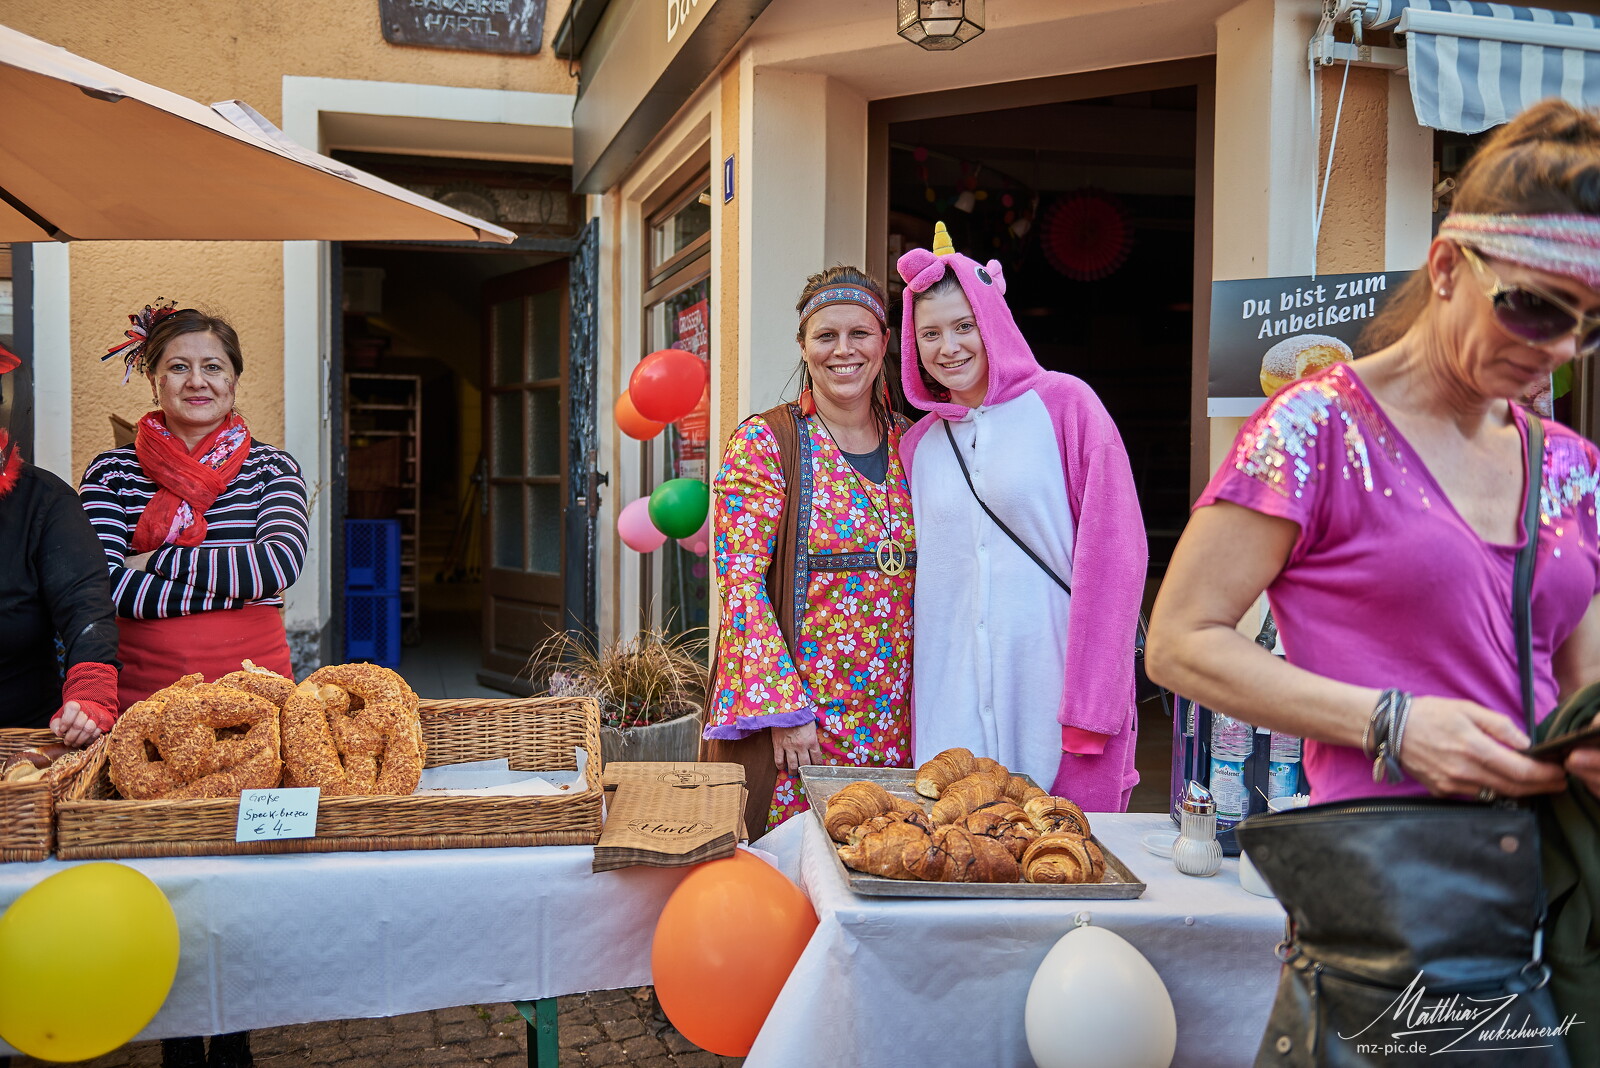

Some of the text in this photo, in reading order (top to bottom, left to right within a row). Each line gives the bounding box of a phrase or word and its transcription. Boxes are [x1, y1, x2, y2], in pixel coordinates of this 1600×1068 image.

[424, 13, 500, 37] HARTL
[726, 165, 731, 194] 1
[1242, 274, 1386, 320] Du bist zum
[1257, 297, 1376, 339] Anbeißen!
[254, 824, 266, 835] €
